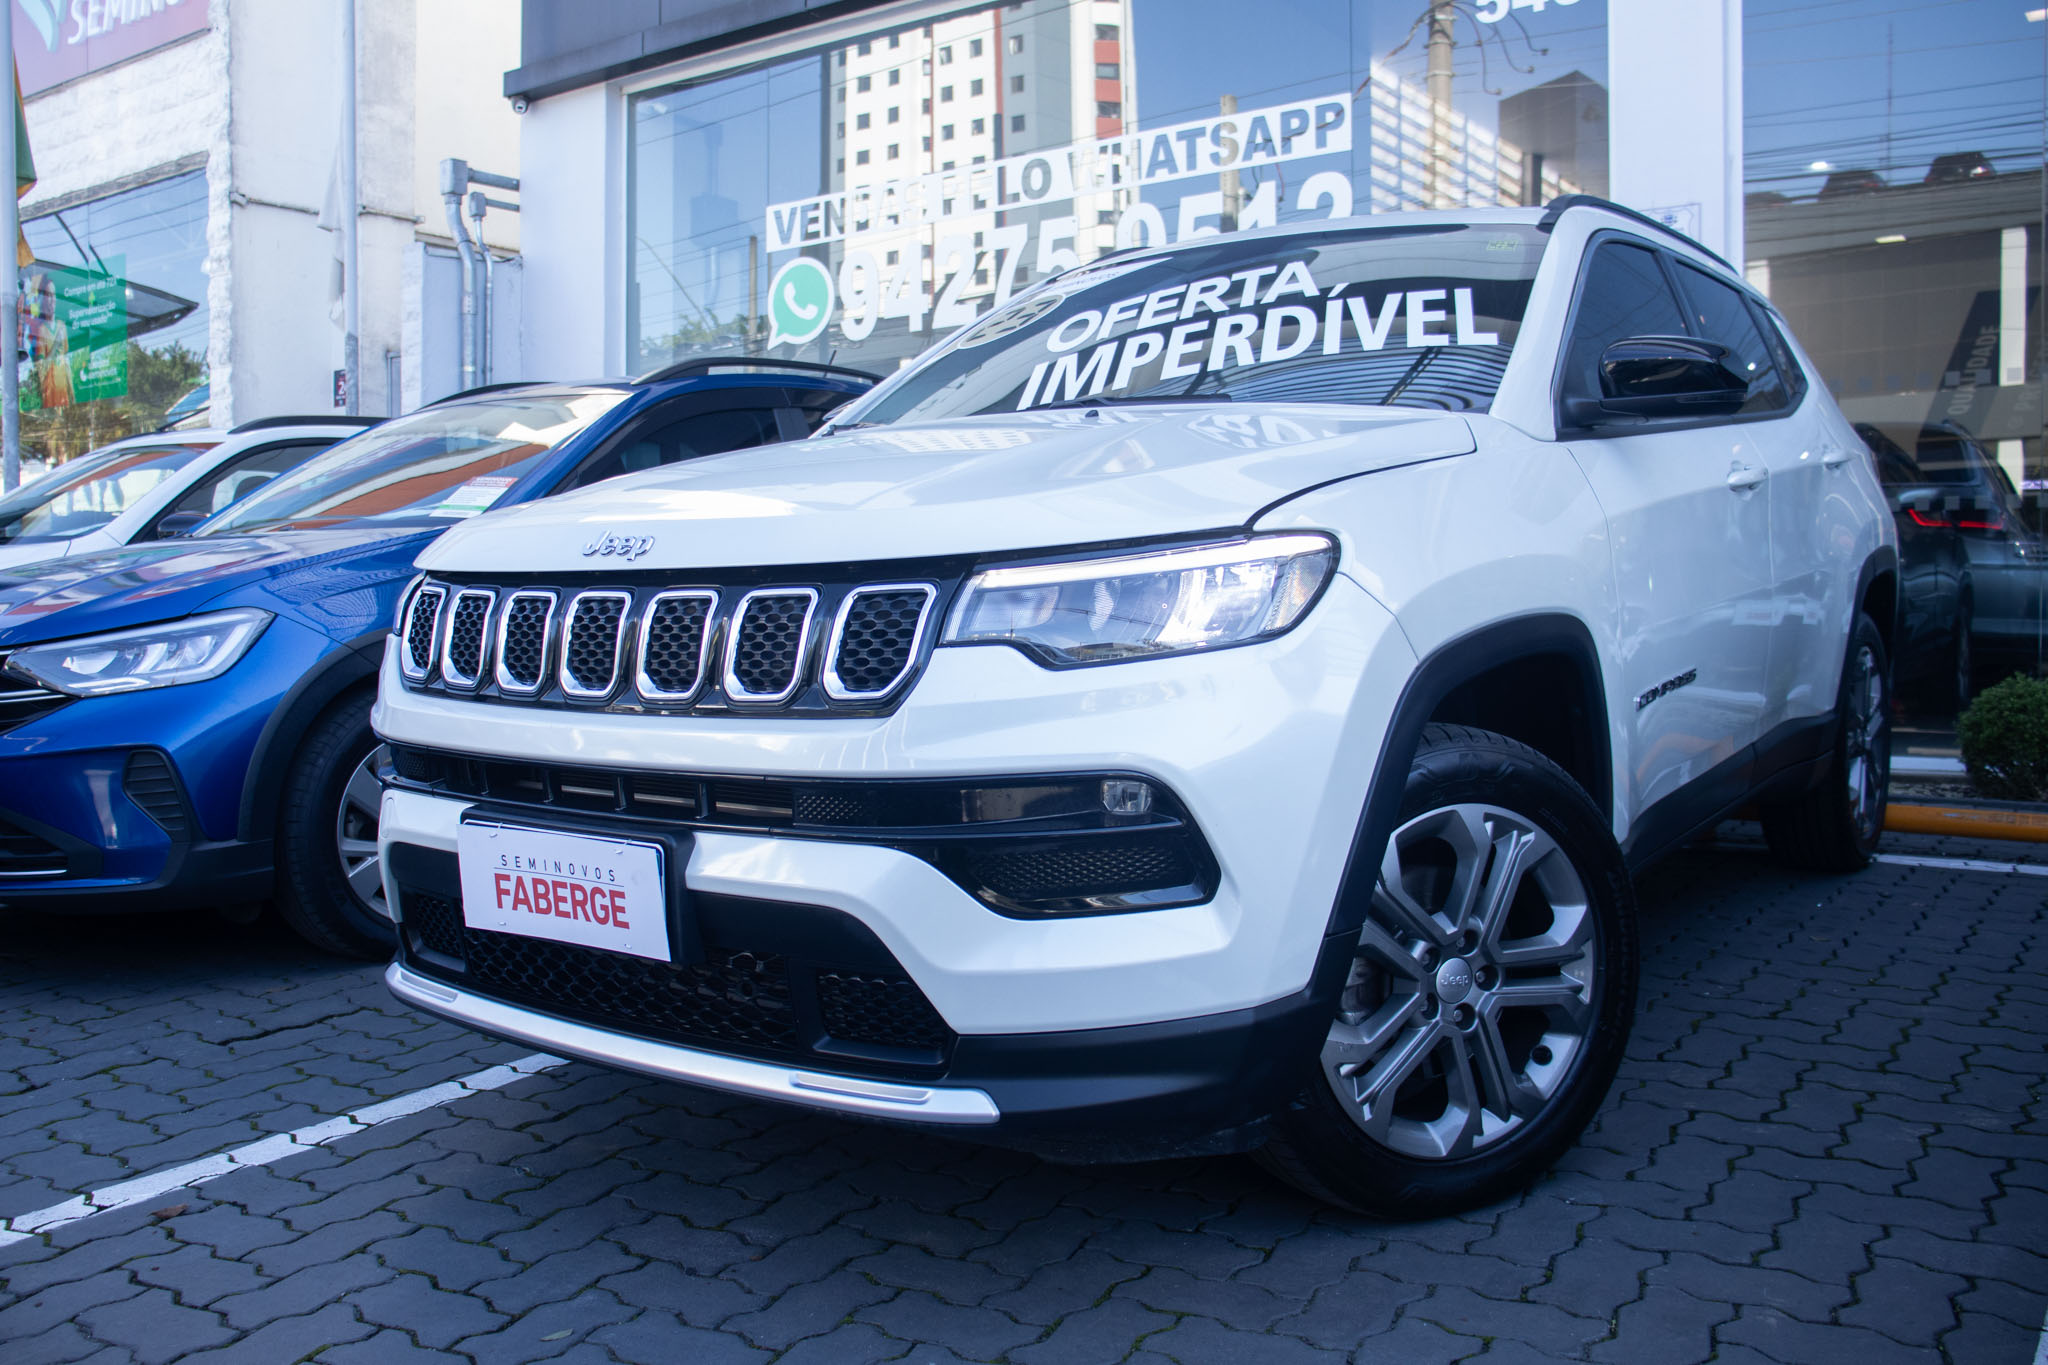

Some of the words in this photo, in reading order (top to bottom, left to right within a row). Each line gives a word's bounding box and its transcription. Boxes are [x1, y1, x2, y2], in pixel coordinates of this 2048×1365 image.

[942, 158, 1052, 216] PELO
[1067, 102, 1345, 190] WHATSAPP
[839, 216, 1081, 341] 94275
[1046, 261, 1320, 353] OFERTA
[1016, 282, 1499, 411] IMPERDÍVEL
[583, 530, 655, 561] Jeep
[494, 873, 630, 930] FABERGE
[500, 854, 616, 882] SEMINOVOS
[1440, 973, 1469, 986] Jeep
